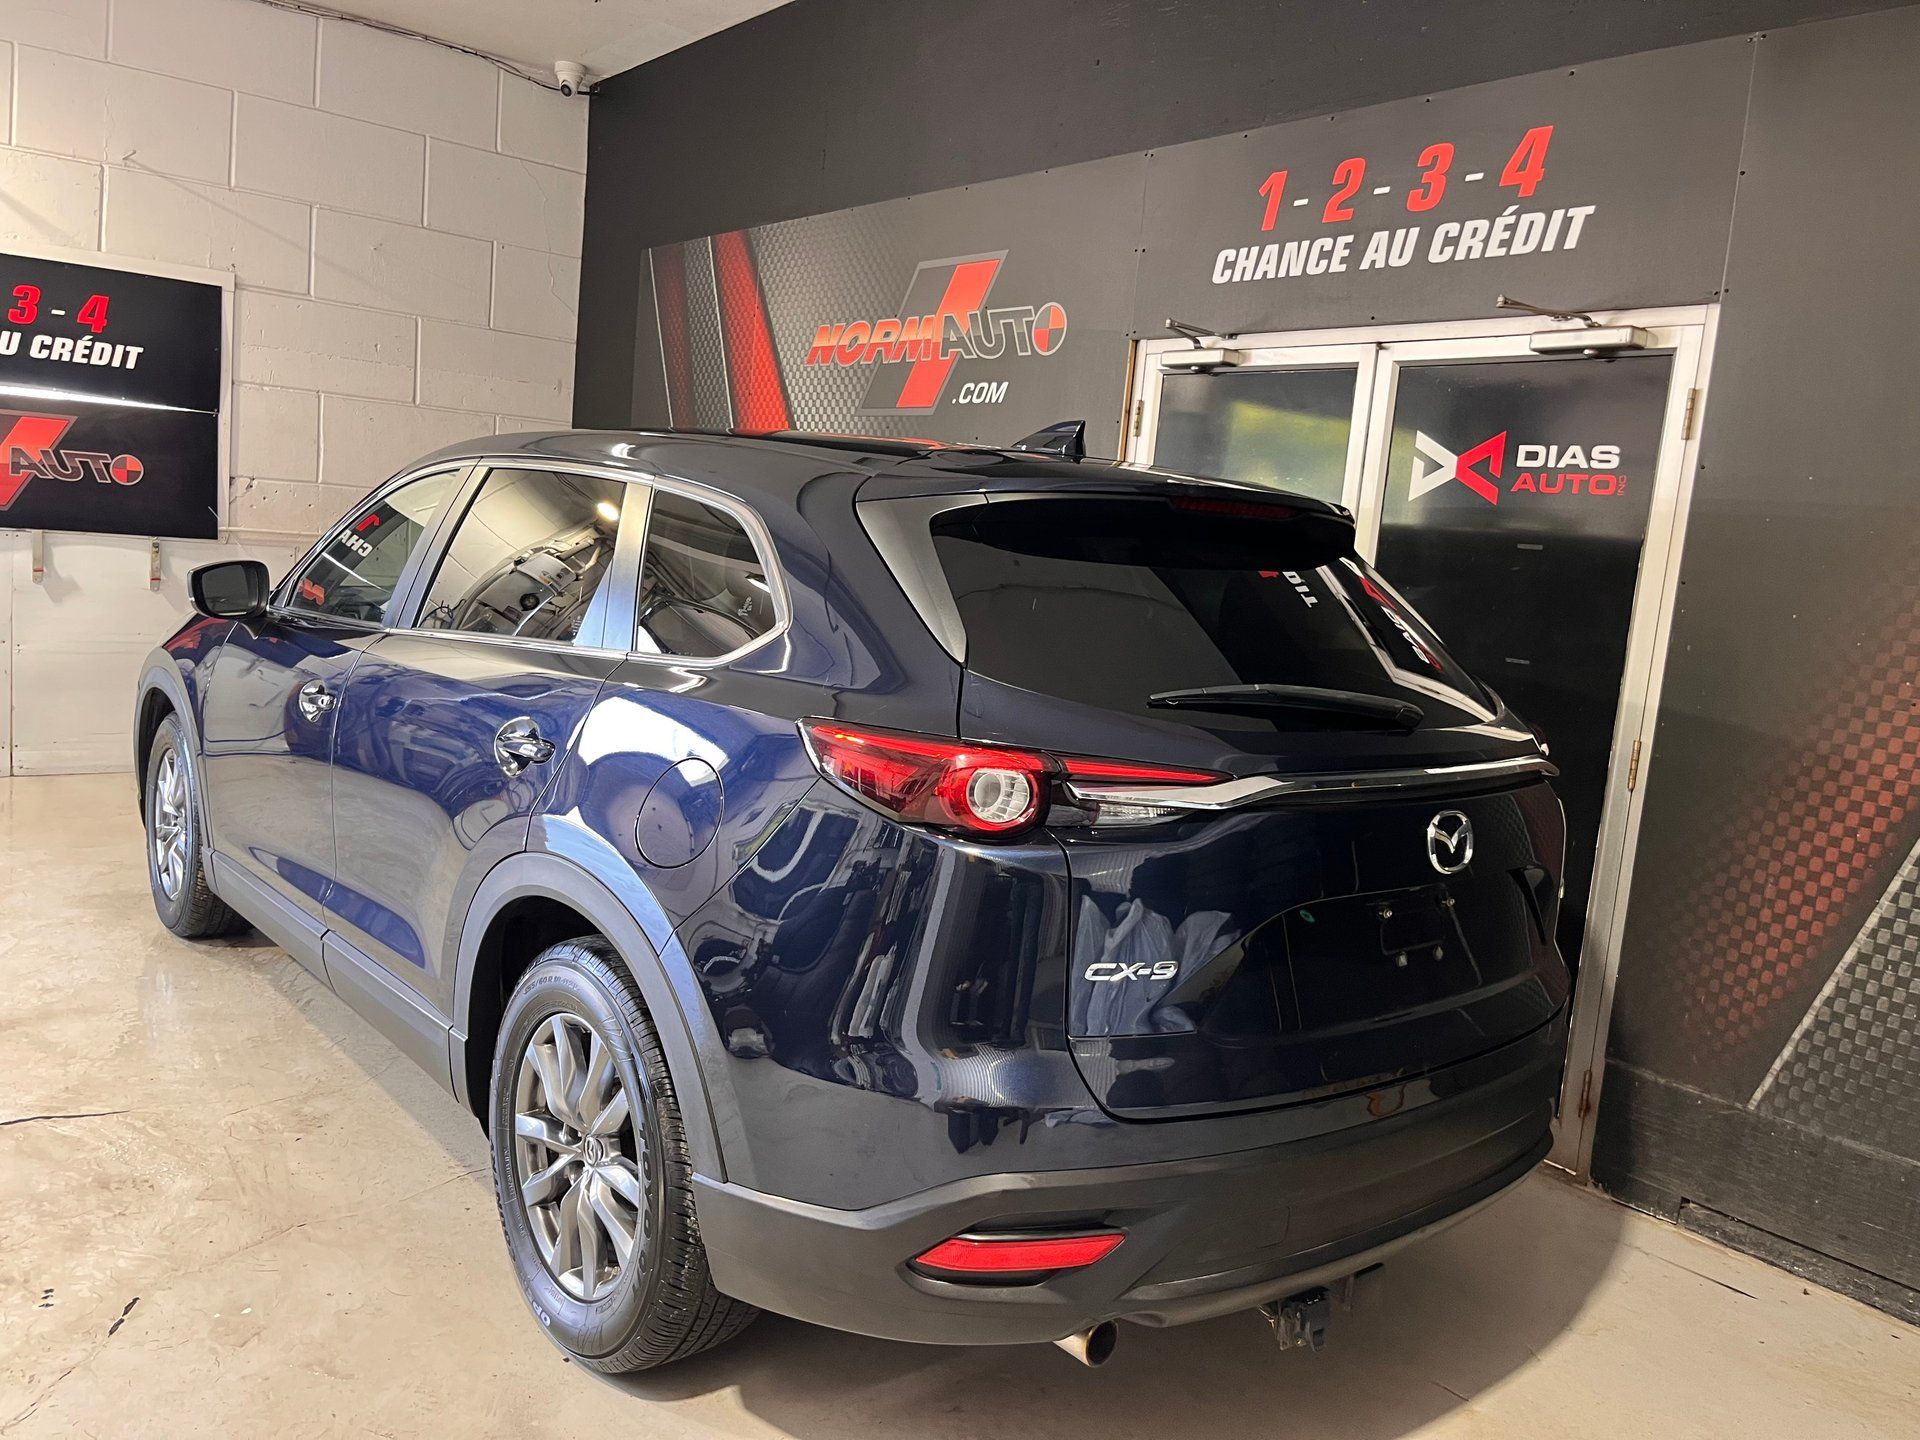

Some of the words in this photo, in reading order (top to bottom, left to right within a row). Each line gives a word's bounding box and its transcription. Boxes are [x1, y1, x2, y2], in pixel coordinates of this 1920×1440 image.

[1258, 171, 1288, 231] 1
[1322, 157, 1366, 223] 2
[1406, 142, 1455, 212] 3
[1499, 125, 1554, 197] 4
[1212, 235, 1354, 284] CHANCE
[1359, 227, 1420, 270] AU
[1428, 205, 1596, 263] CRÉDIT
[7, 284, 41, 325] 3
[77, 294, 110, 333] 4
[0, 330, 22, 356] U
[29, 335, 144, 370] CRÉDIT
[951, 381, 1009, 405] .COM
[1516, 444, 1621, 469] DIAS
[1510, 472, 1617, 496] AUTO
[1084, 960, 1178, 982] CX-9
